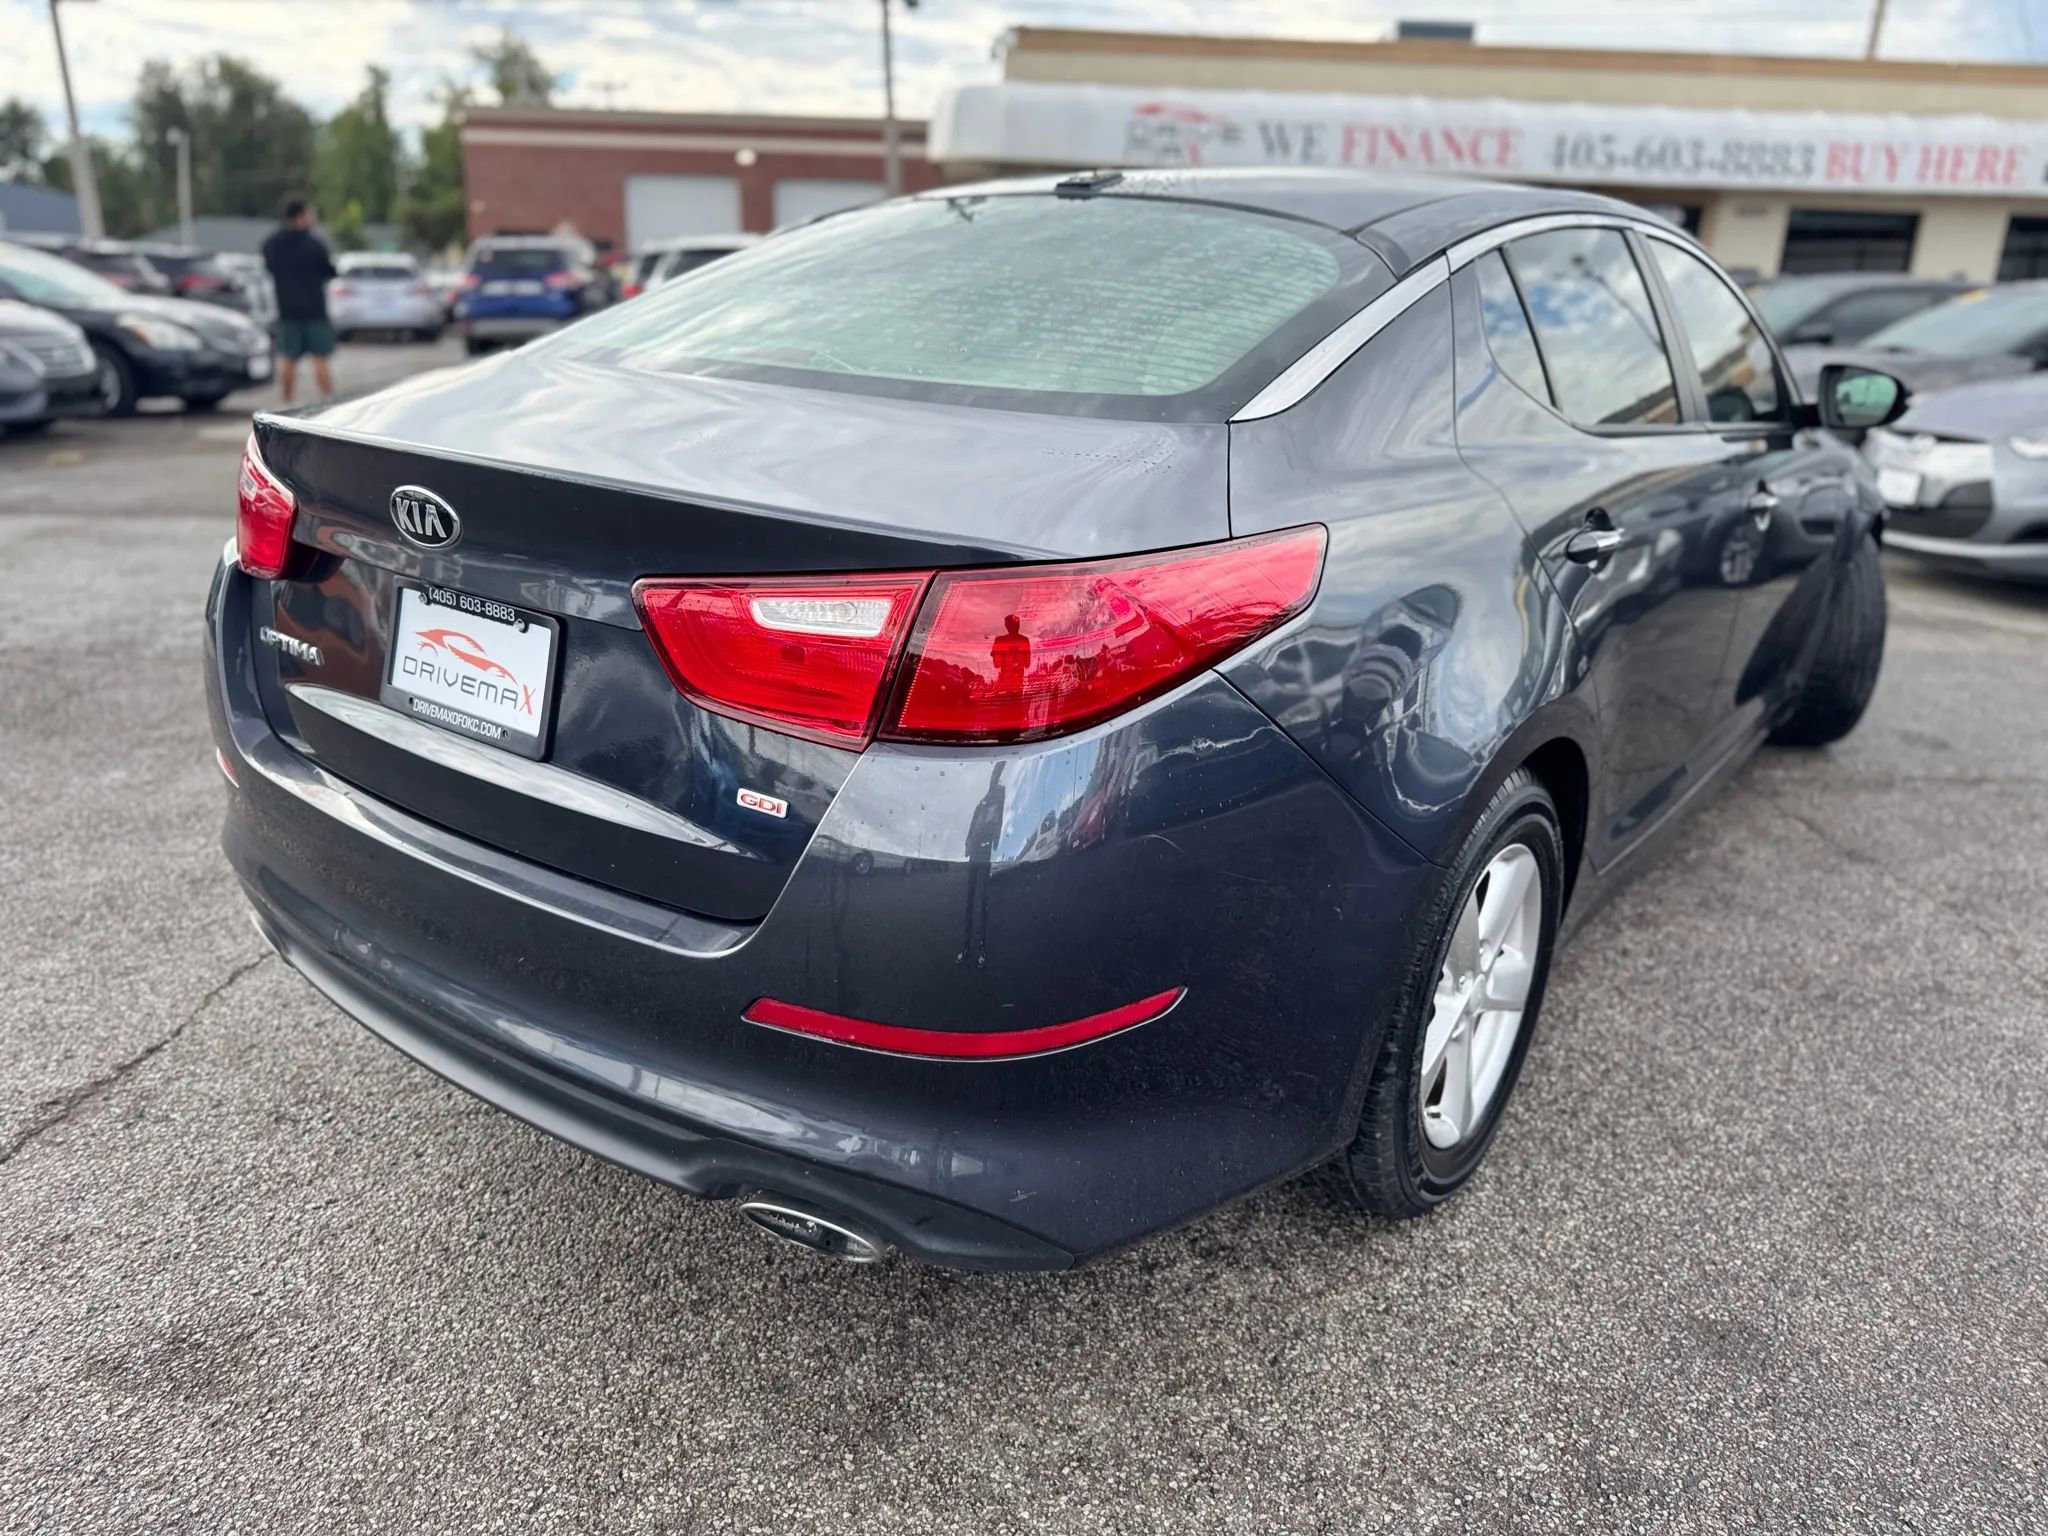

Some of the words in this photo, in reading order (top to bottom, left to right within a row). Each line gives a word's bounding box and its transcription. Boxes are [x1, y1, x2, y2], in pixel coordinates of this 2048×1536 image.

[1258, 120, 1326, 161] WE
[1340, 122, 1522, 169] FINANCE
[1824, 140, 1904, 183] BUY
[1917, 142, 2027, 186] HERE
[395, 496, 448, 539] KIA
[429, 587, 457, 607] (405)
[459, 595, 516, 622] 603-8883
[260, 626, 325, 666] OPTIMA
[402, 655, 536, 716] DRIVEMAX
[412, 698, 502, 740] DRIVEMAXOFOKC.COM
